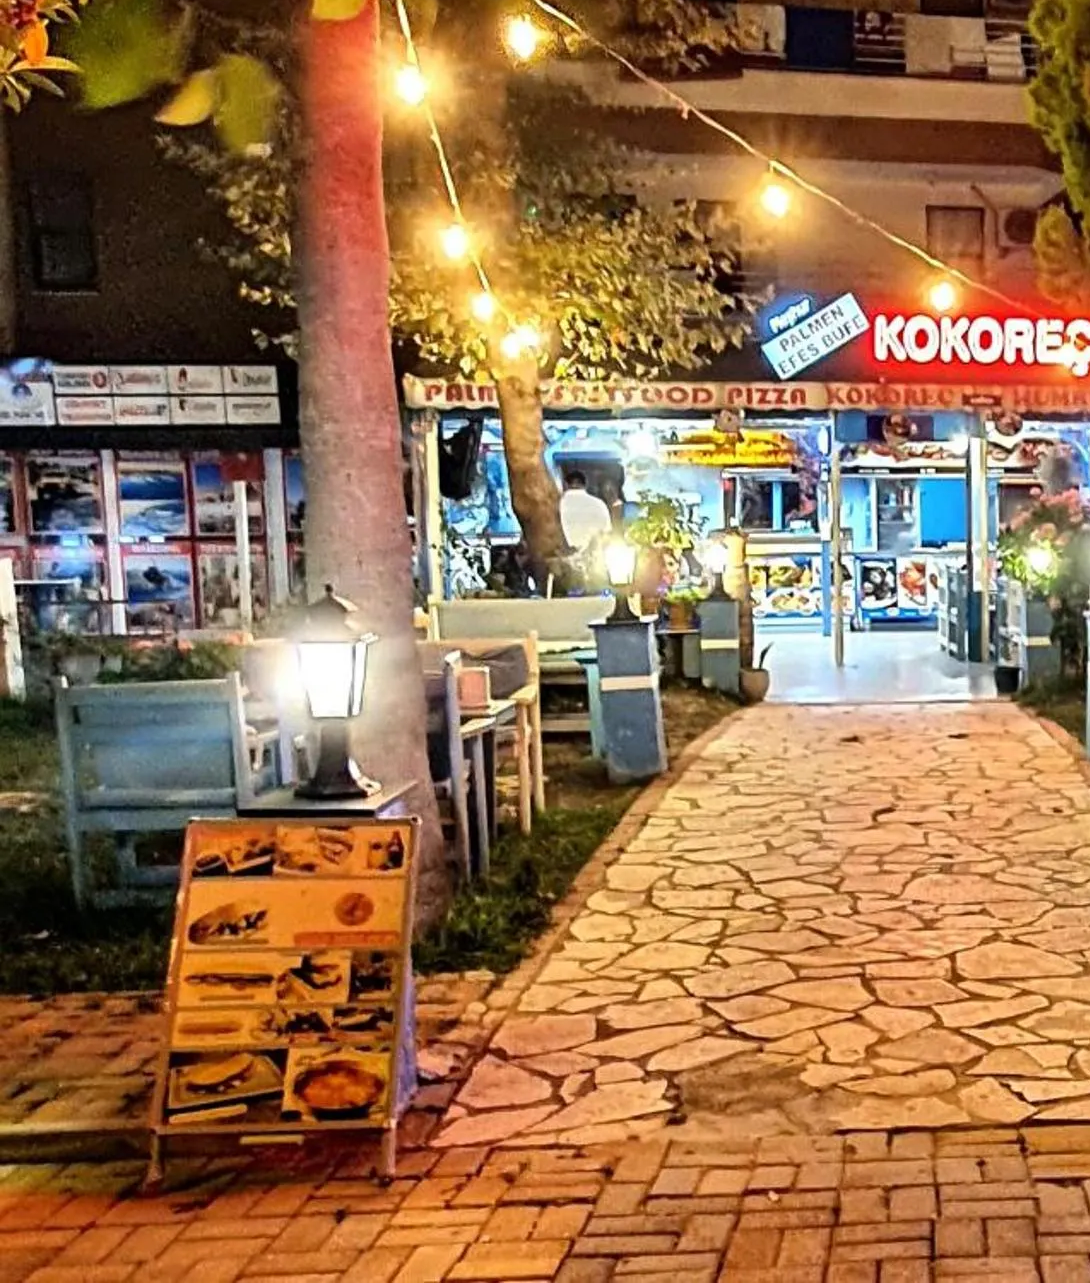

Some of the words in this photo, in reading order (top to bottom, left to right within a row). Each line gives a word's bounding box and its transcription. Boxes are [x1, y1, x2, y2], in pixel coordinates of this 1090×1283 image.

[779, 304, 845, 353] PALMEN
[777, 343, 820, 376] EFES
[727, 387, 807, 406] PIZZA
